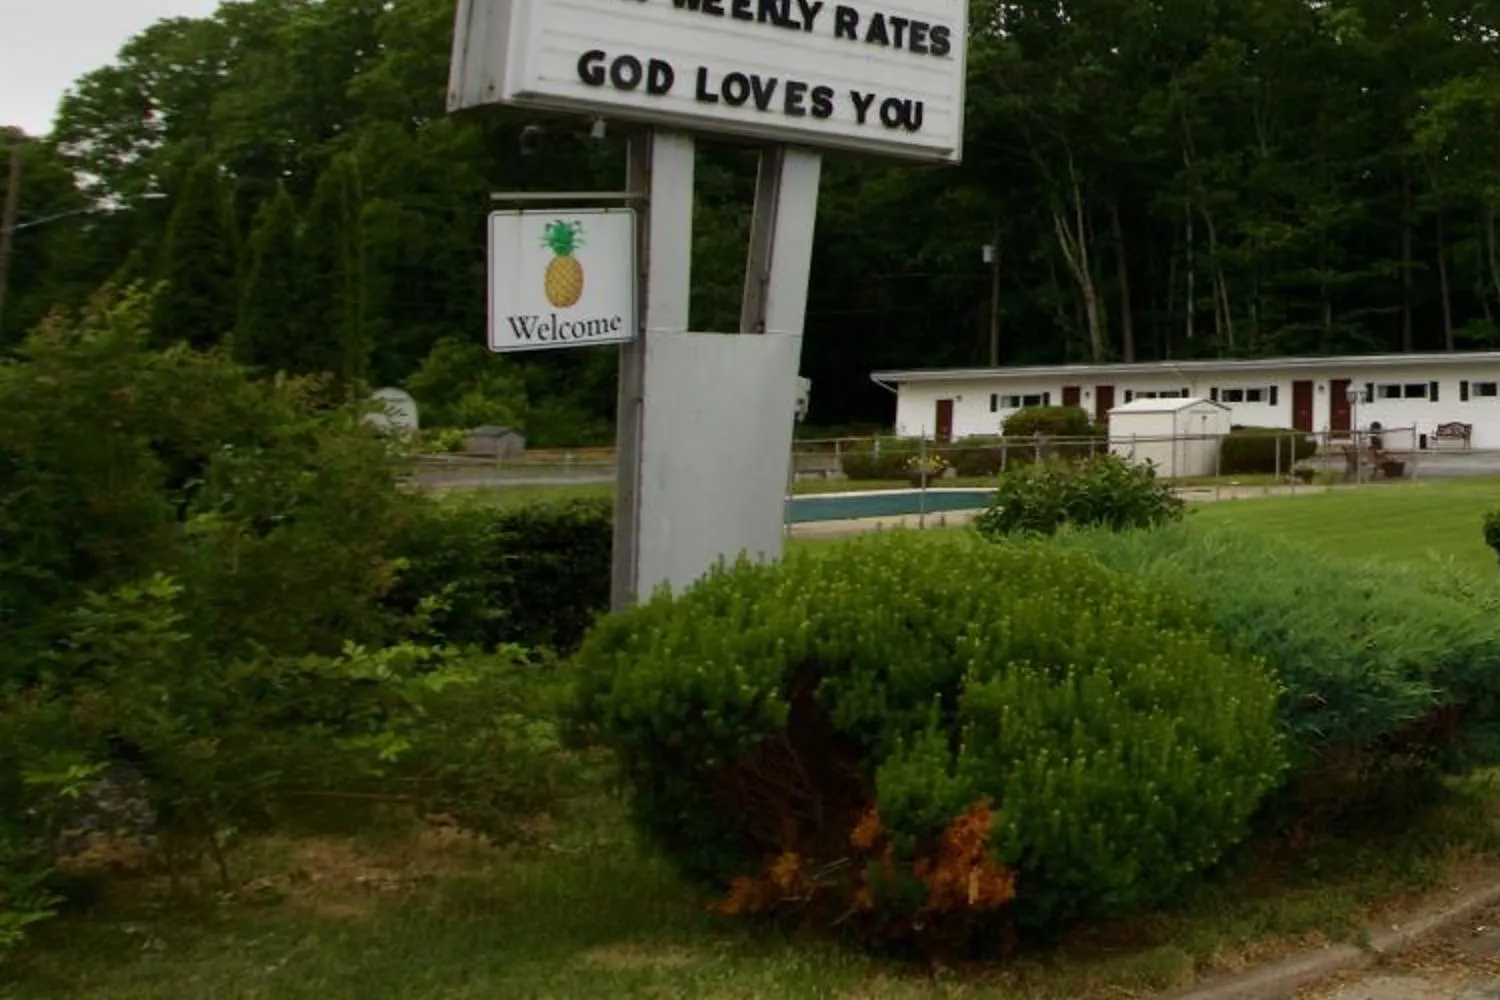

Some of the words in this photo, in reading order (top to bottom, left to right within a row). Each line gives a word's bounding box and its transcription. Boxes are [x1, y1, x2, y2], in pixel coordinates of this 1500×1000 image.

[834, 5, 952, 57] RATES
[577, 49, 675, 95] GOD
[695, 67, 834, 120] LOVES
[849, 90, 924, 133] YOU
[507, 313, 622, 342] Welcome
